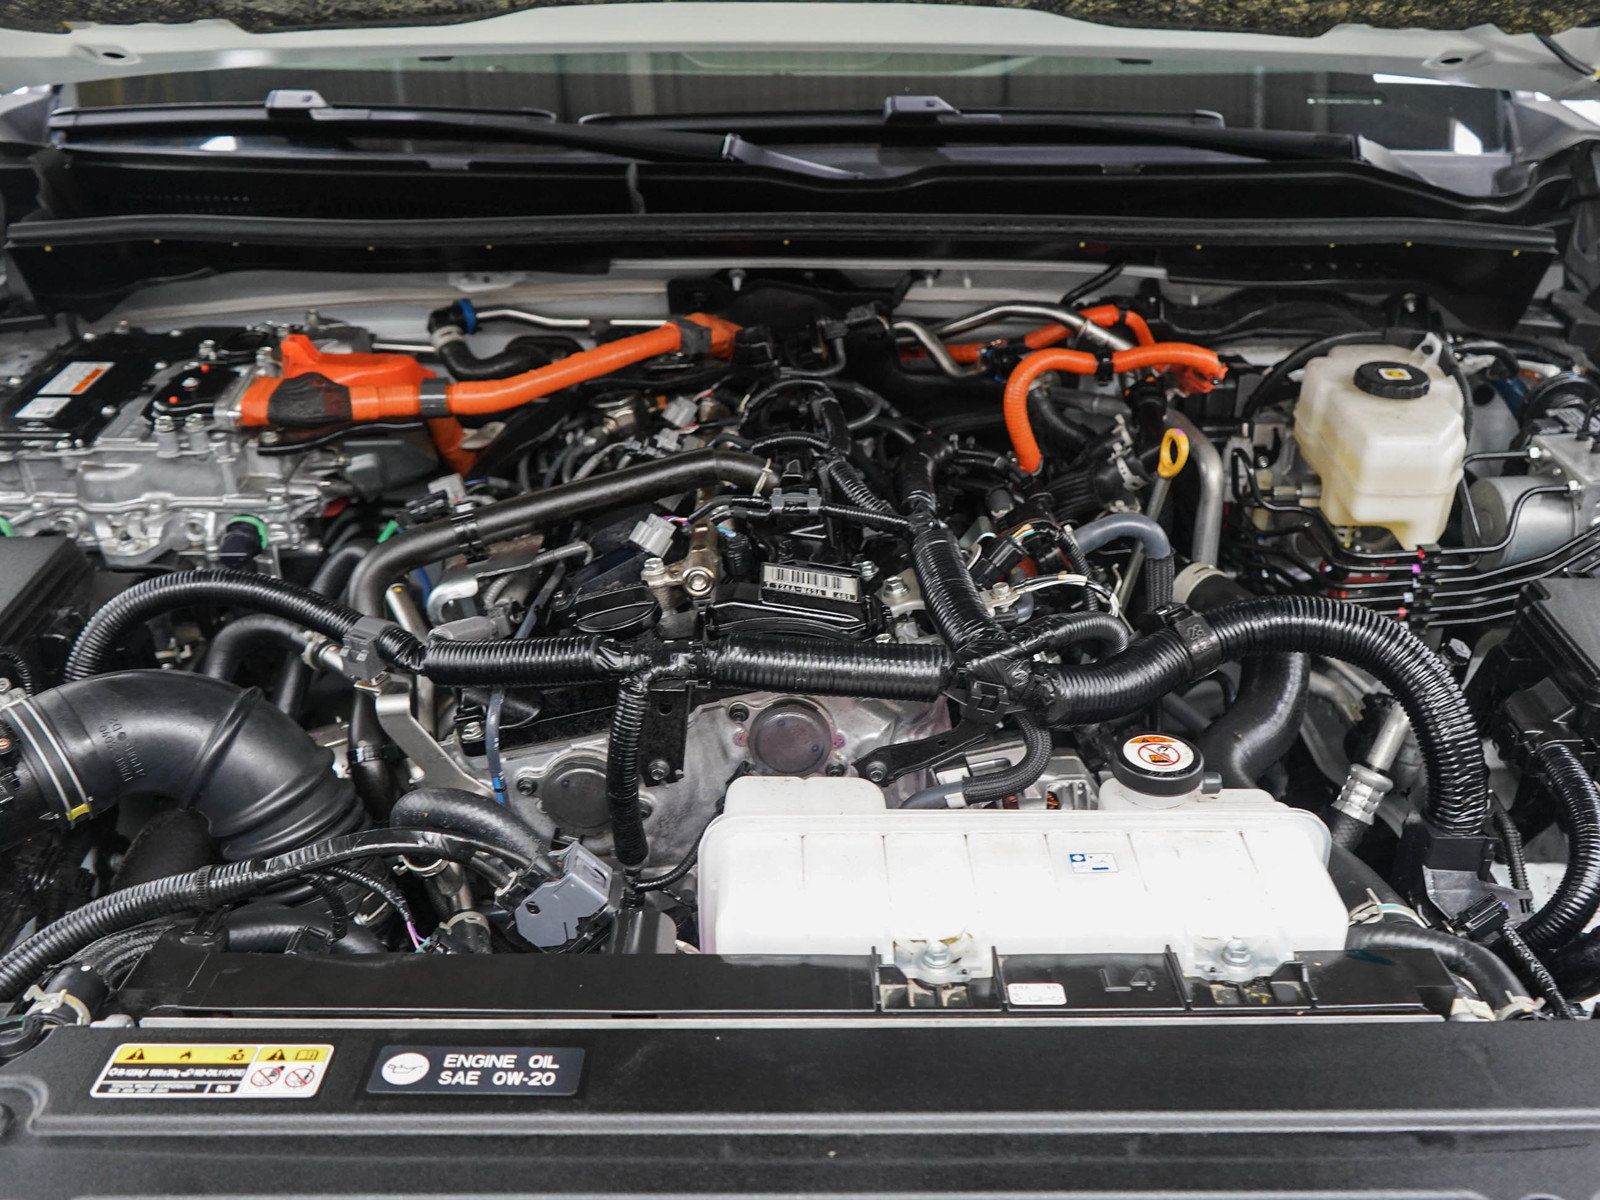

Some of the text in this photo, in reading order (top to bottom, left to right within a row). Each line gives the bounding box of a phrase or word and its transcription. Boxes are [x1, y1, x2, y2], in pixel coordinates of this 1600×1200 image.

[443, 1054, 559, 1069] ENGINE OIL
[438, 1070, 481, 1085] SAE
